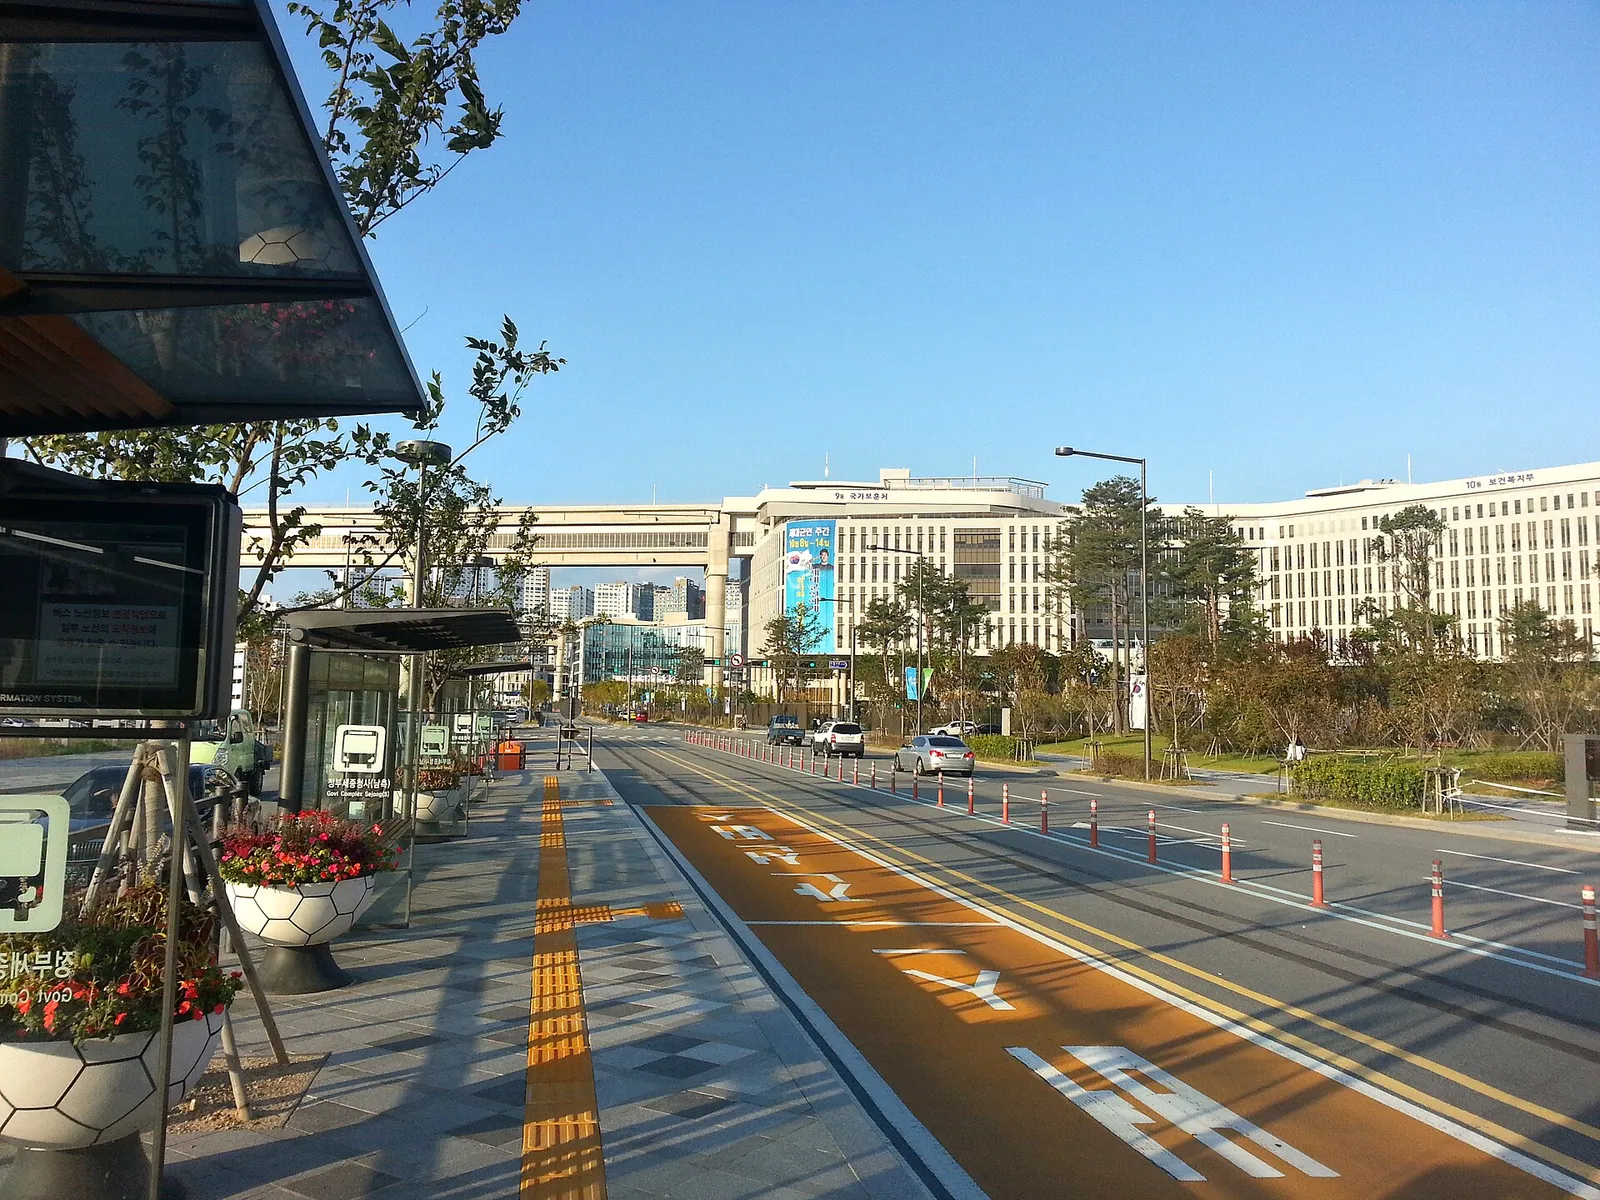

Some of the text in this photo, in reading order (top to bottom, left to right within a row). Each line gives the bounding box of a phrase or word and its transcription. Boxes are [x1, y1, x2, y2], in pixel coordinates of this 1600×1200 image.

[1489, 473, 1535, 486] 보건복지부
[850, 492, 888, 501] 국가보훈처
[815, 526, 830, 537] 주간
[44, 694, 82, 703] SYSTEM
